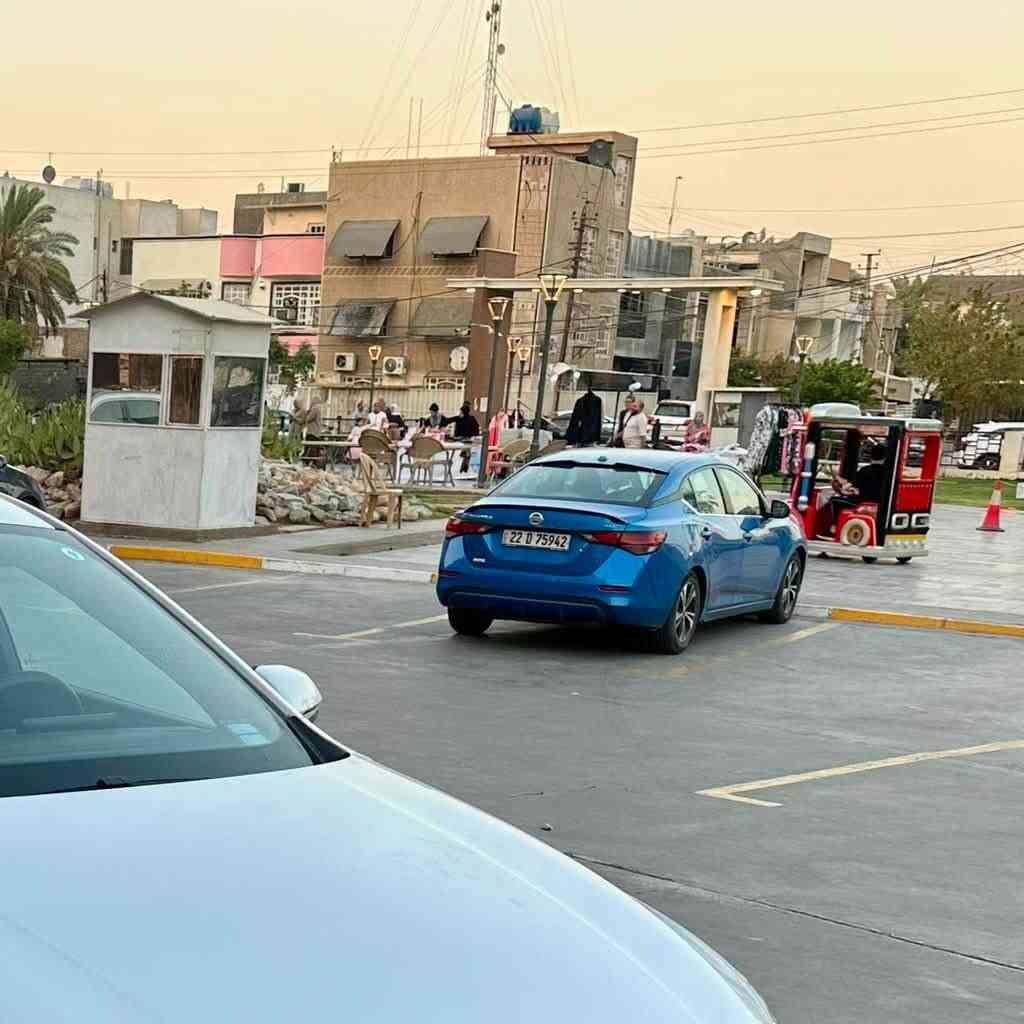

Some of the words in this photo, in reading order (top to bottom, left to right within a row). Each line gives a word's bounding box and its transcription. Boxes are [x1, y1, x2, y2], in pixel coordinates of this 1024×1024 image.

[510, 531, 523, 543] 22
[526, 532, 533, 544] D
[536, 533, 568, 547] 75942
